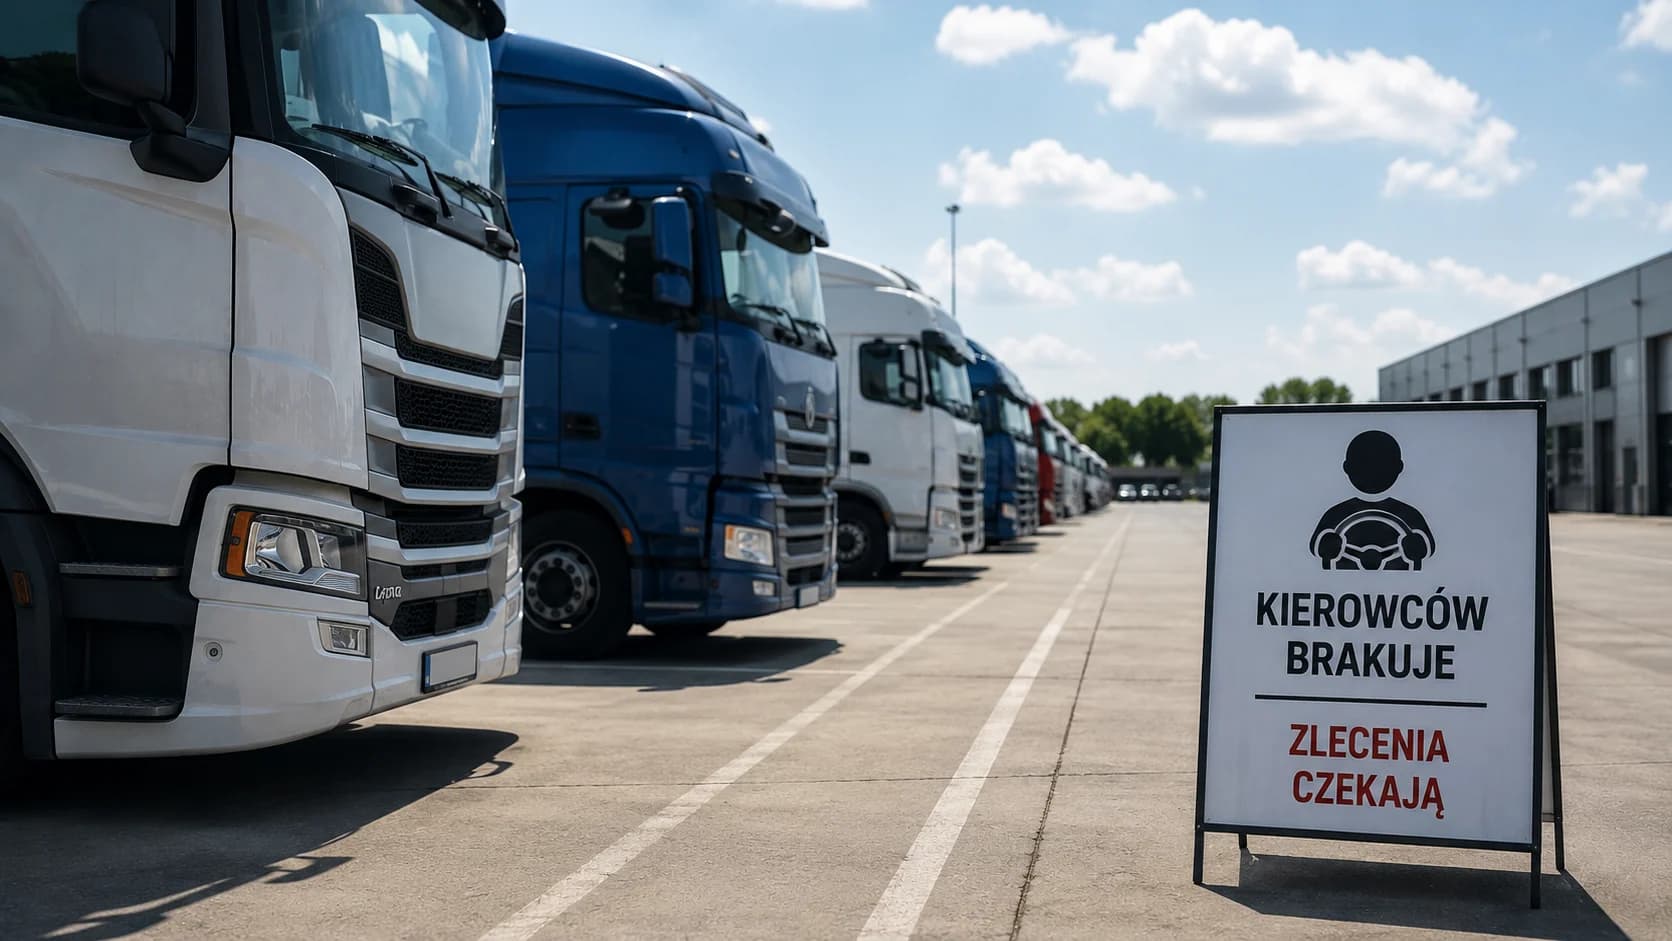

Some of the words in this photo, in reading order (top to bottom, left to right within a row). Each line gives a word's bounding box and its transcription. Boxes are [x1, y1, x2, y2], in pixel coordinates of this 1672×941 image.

[1256, 586, 1489, 631] KIEROWCÓW
[1286, 640, 1456, 680] BRAKUJE
[1288, 723, 1450, 763] ZLECENIA
[1292, 770, 1445, 820] CZEKAJĄ
